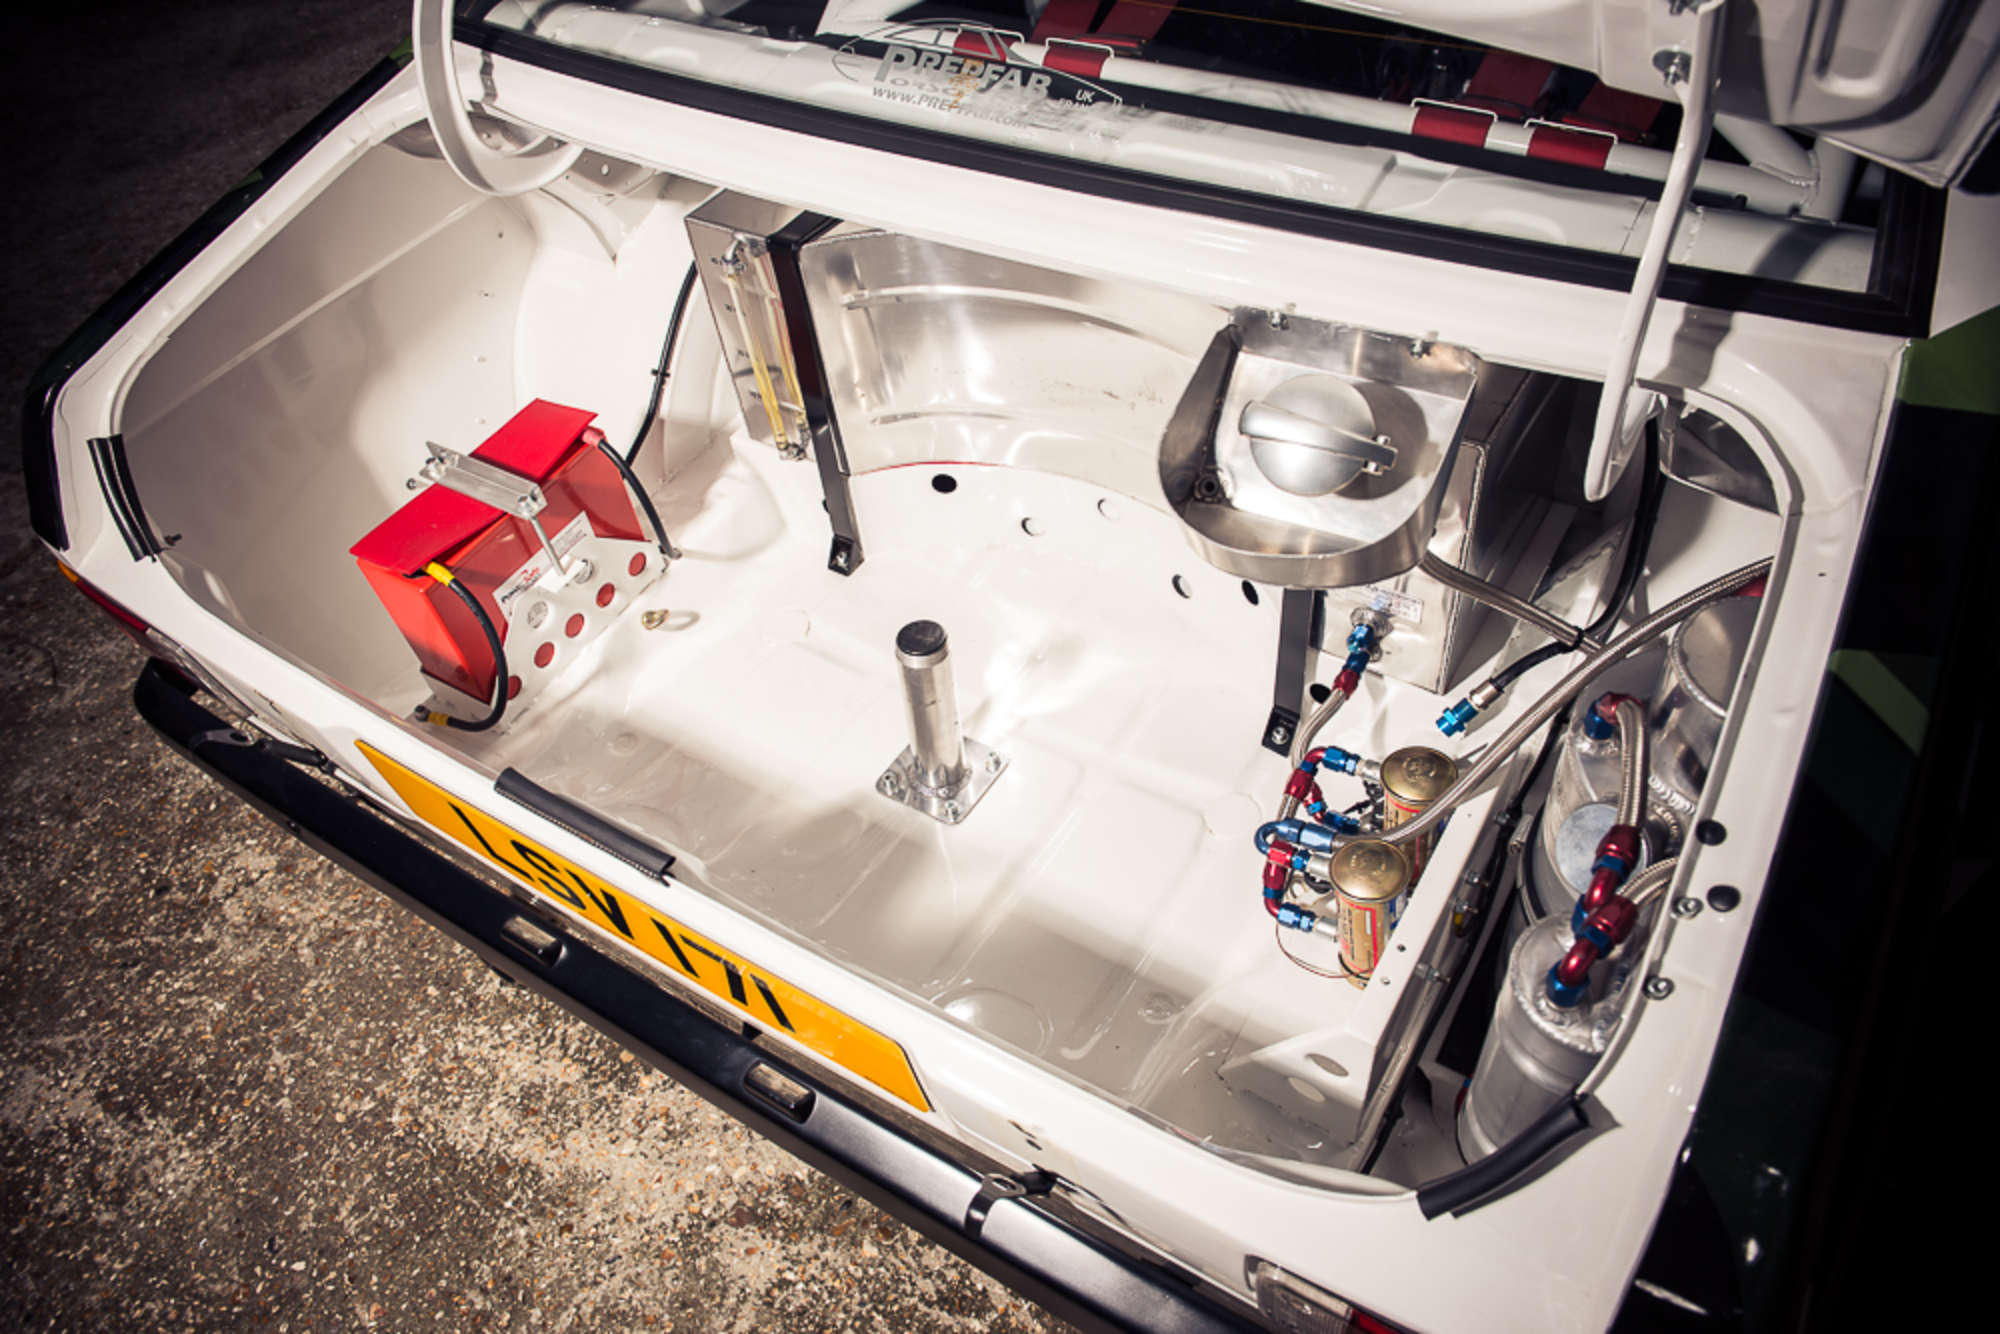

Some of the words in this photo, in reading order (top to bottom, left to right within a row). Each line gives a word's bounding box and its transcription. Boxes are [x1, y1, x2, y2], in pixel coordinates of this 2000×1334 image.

[874, 44, 1053, 99] PREPFAB
[1075, 88, 1096, 104] UK
[448, 801, 635, 941] LSV
[649, 916, 797, 1034] 171
